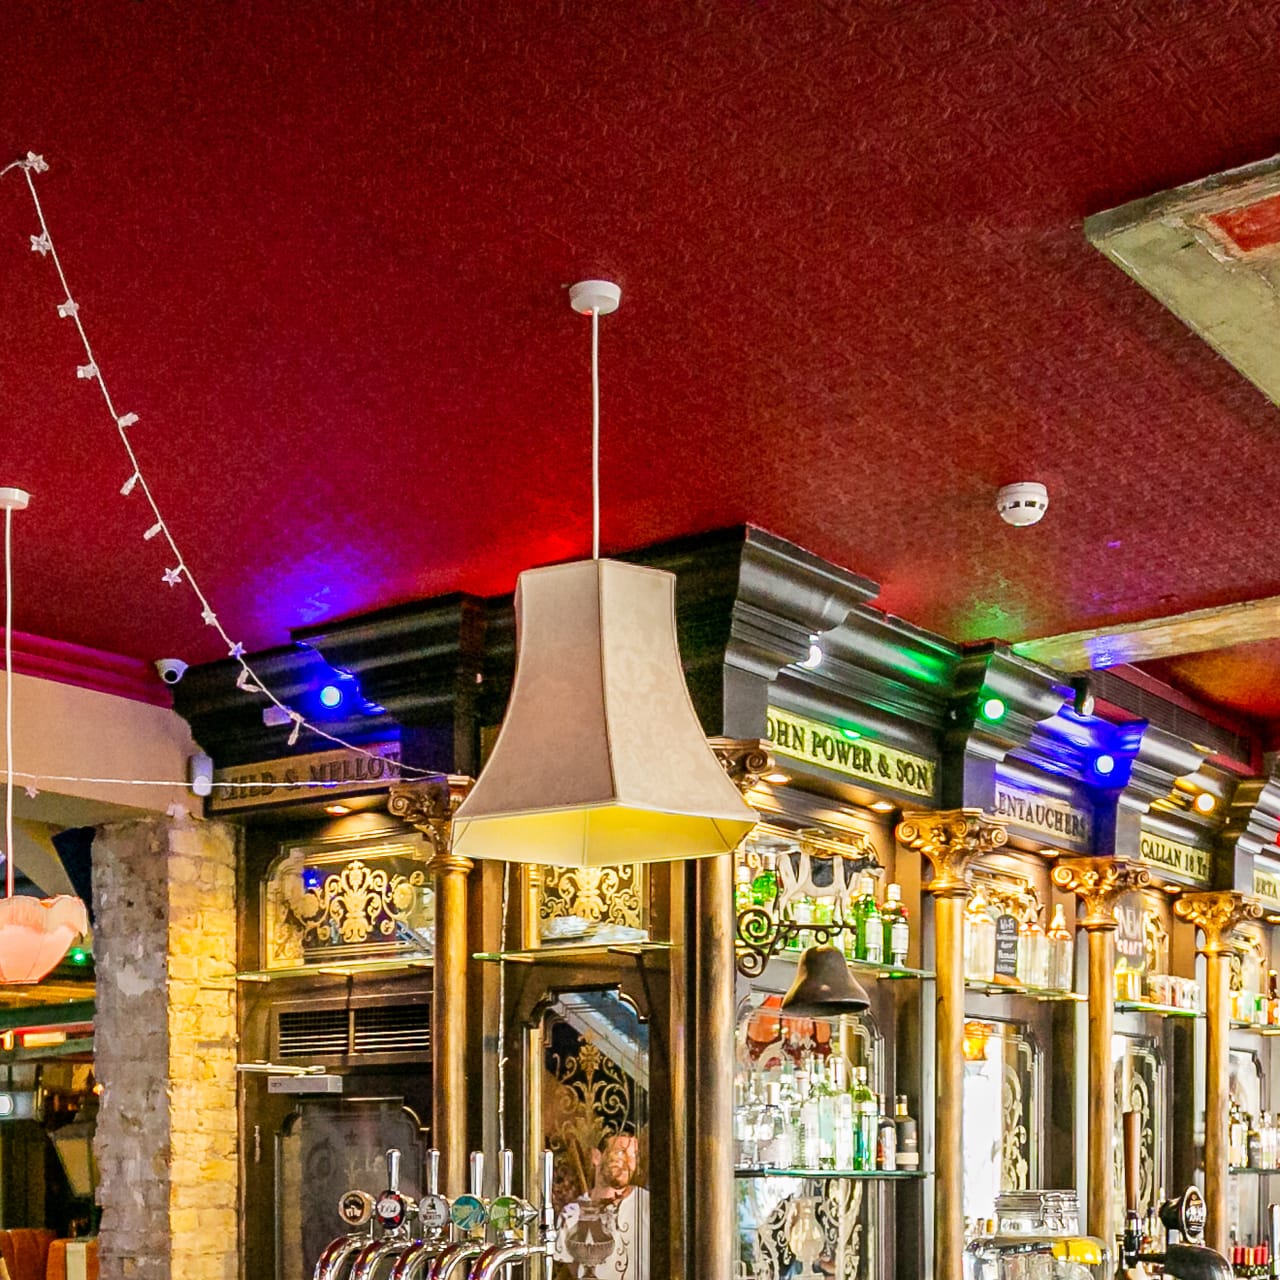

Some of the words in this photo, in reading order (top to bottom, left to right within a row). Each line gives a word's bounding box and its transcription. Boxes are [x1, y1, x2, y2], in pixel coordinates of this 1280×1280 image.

[766, 716, 806, 753] OHN
[811, 730, 874, 774] POWER
[877, 753, 892, 780] &
[896, 758, 929, 792] SON
[998, 790, 1087, 840] ENTAUCHERS
[1141, 838, 1182, 868] CALLAN
